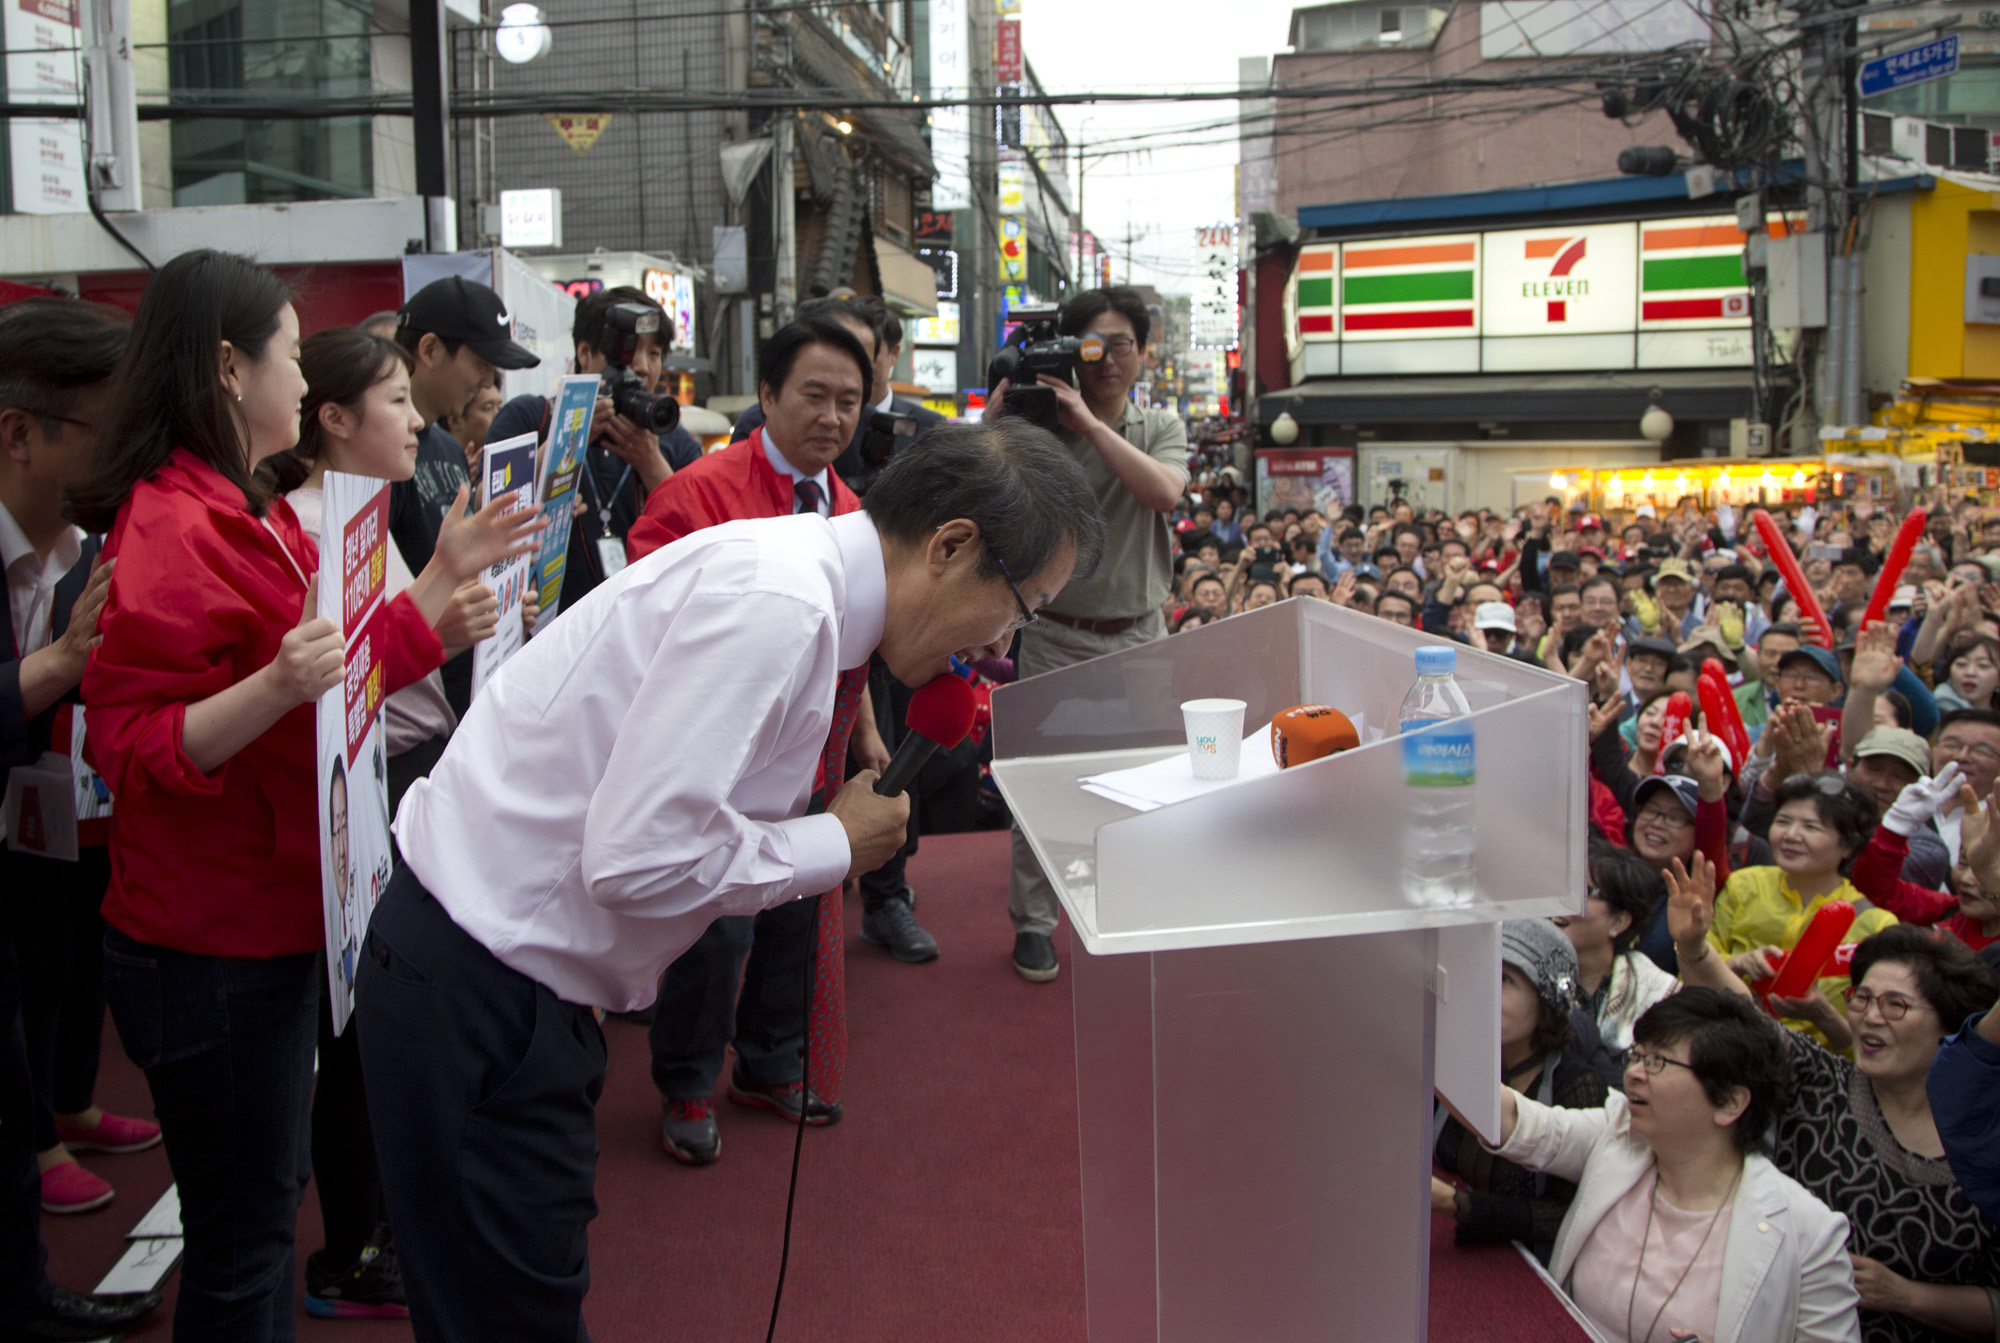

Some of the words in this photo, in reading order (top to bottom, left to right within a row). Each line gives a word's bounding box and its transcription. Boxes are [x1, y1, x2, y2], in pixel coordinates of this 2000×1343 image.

[1082, 345, 1102, 356] MBN
[345, 526, 359, 577] 청년
[360, 505, 379, 561] 일자리
[345, 558, 370, 625] 110만개
[371, 541, 386, 590] 창출!
[346, 633, 370, 704] 공정채용
[348, 684, 367, 746] 특별법
[366, 659, 382, 711] 제정!
[1196, 735, 1216, 747] you
[1202, 743, 1217, 755] us
